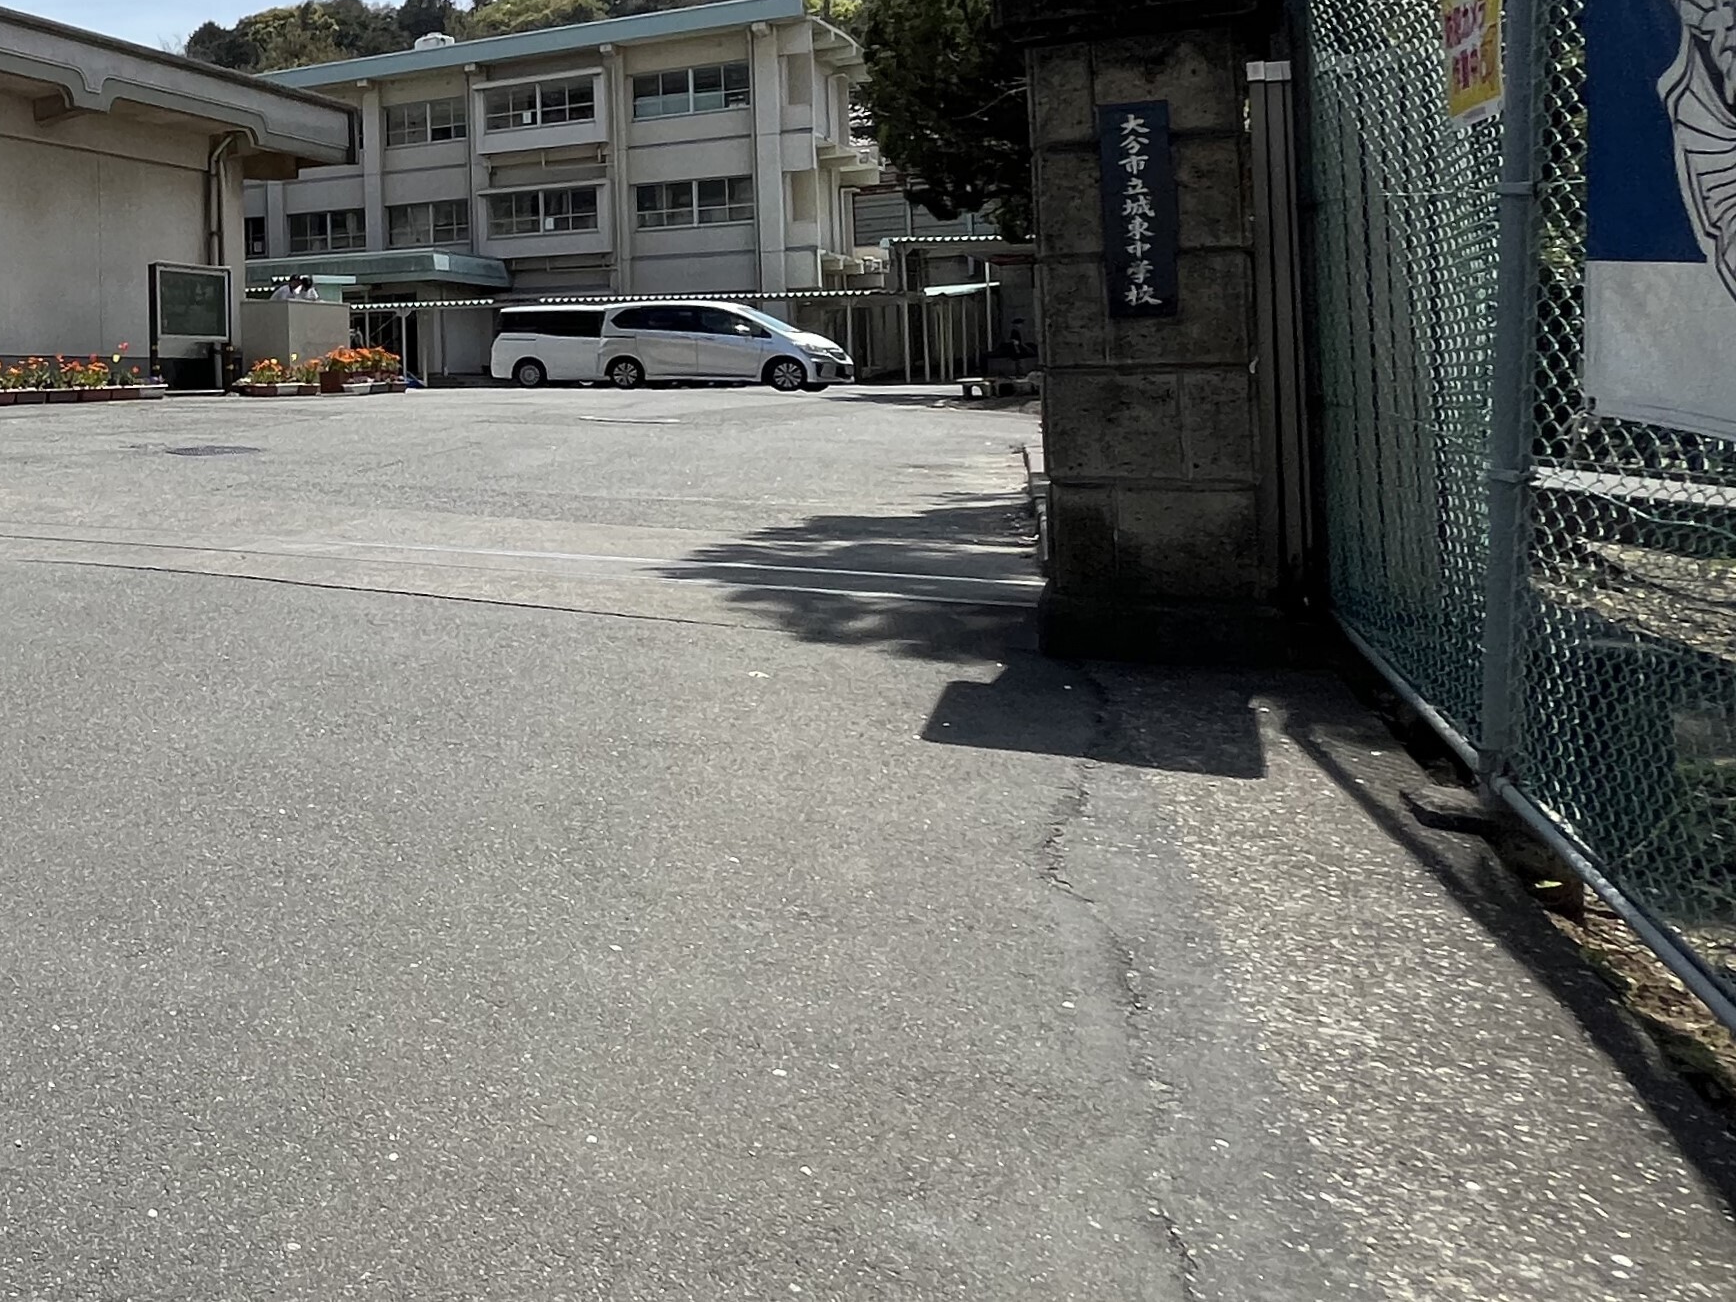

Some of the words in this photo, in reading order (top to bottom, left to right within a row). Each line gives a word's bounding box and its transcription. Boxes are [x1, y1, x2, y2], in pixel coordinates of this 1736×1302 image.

[1118, 114, 1163, 306] 大分市立城東中学校
